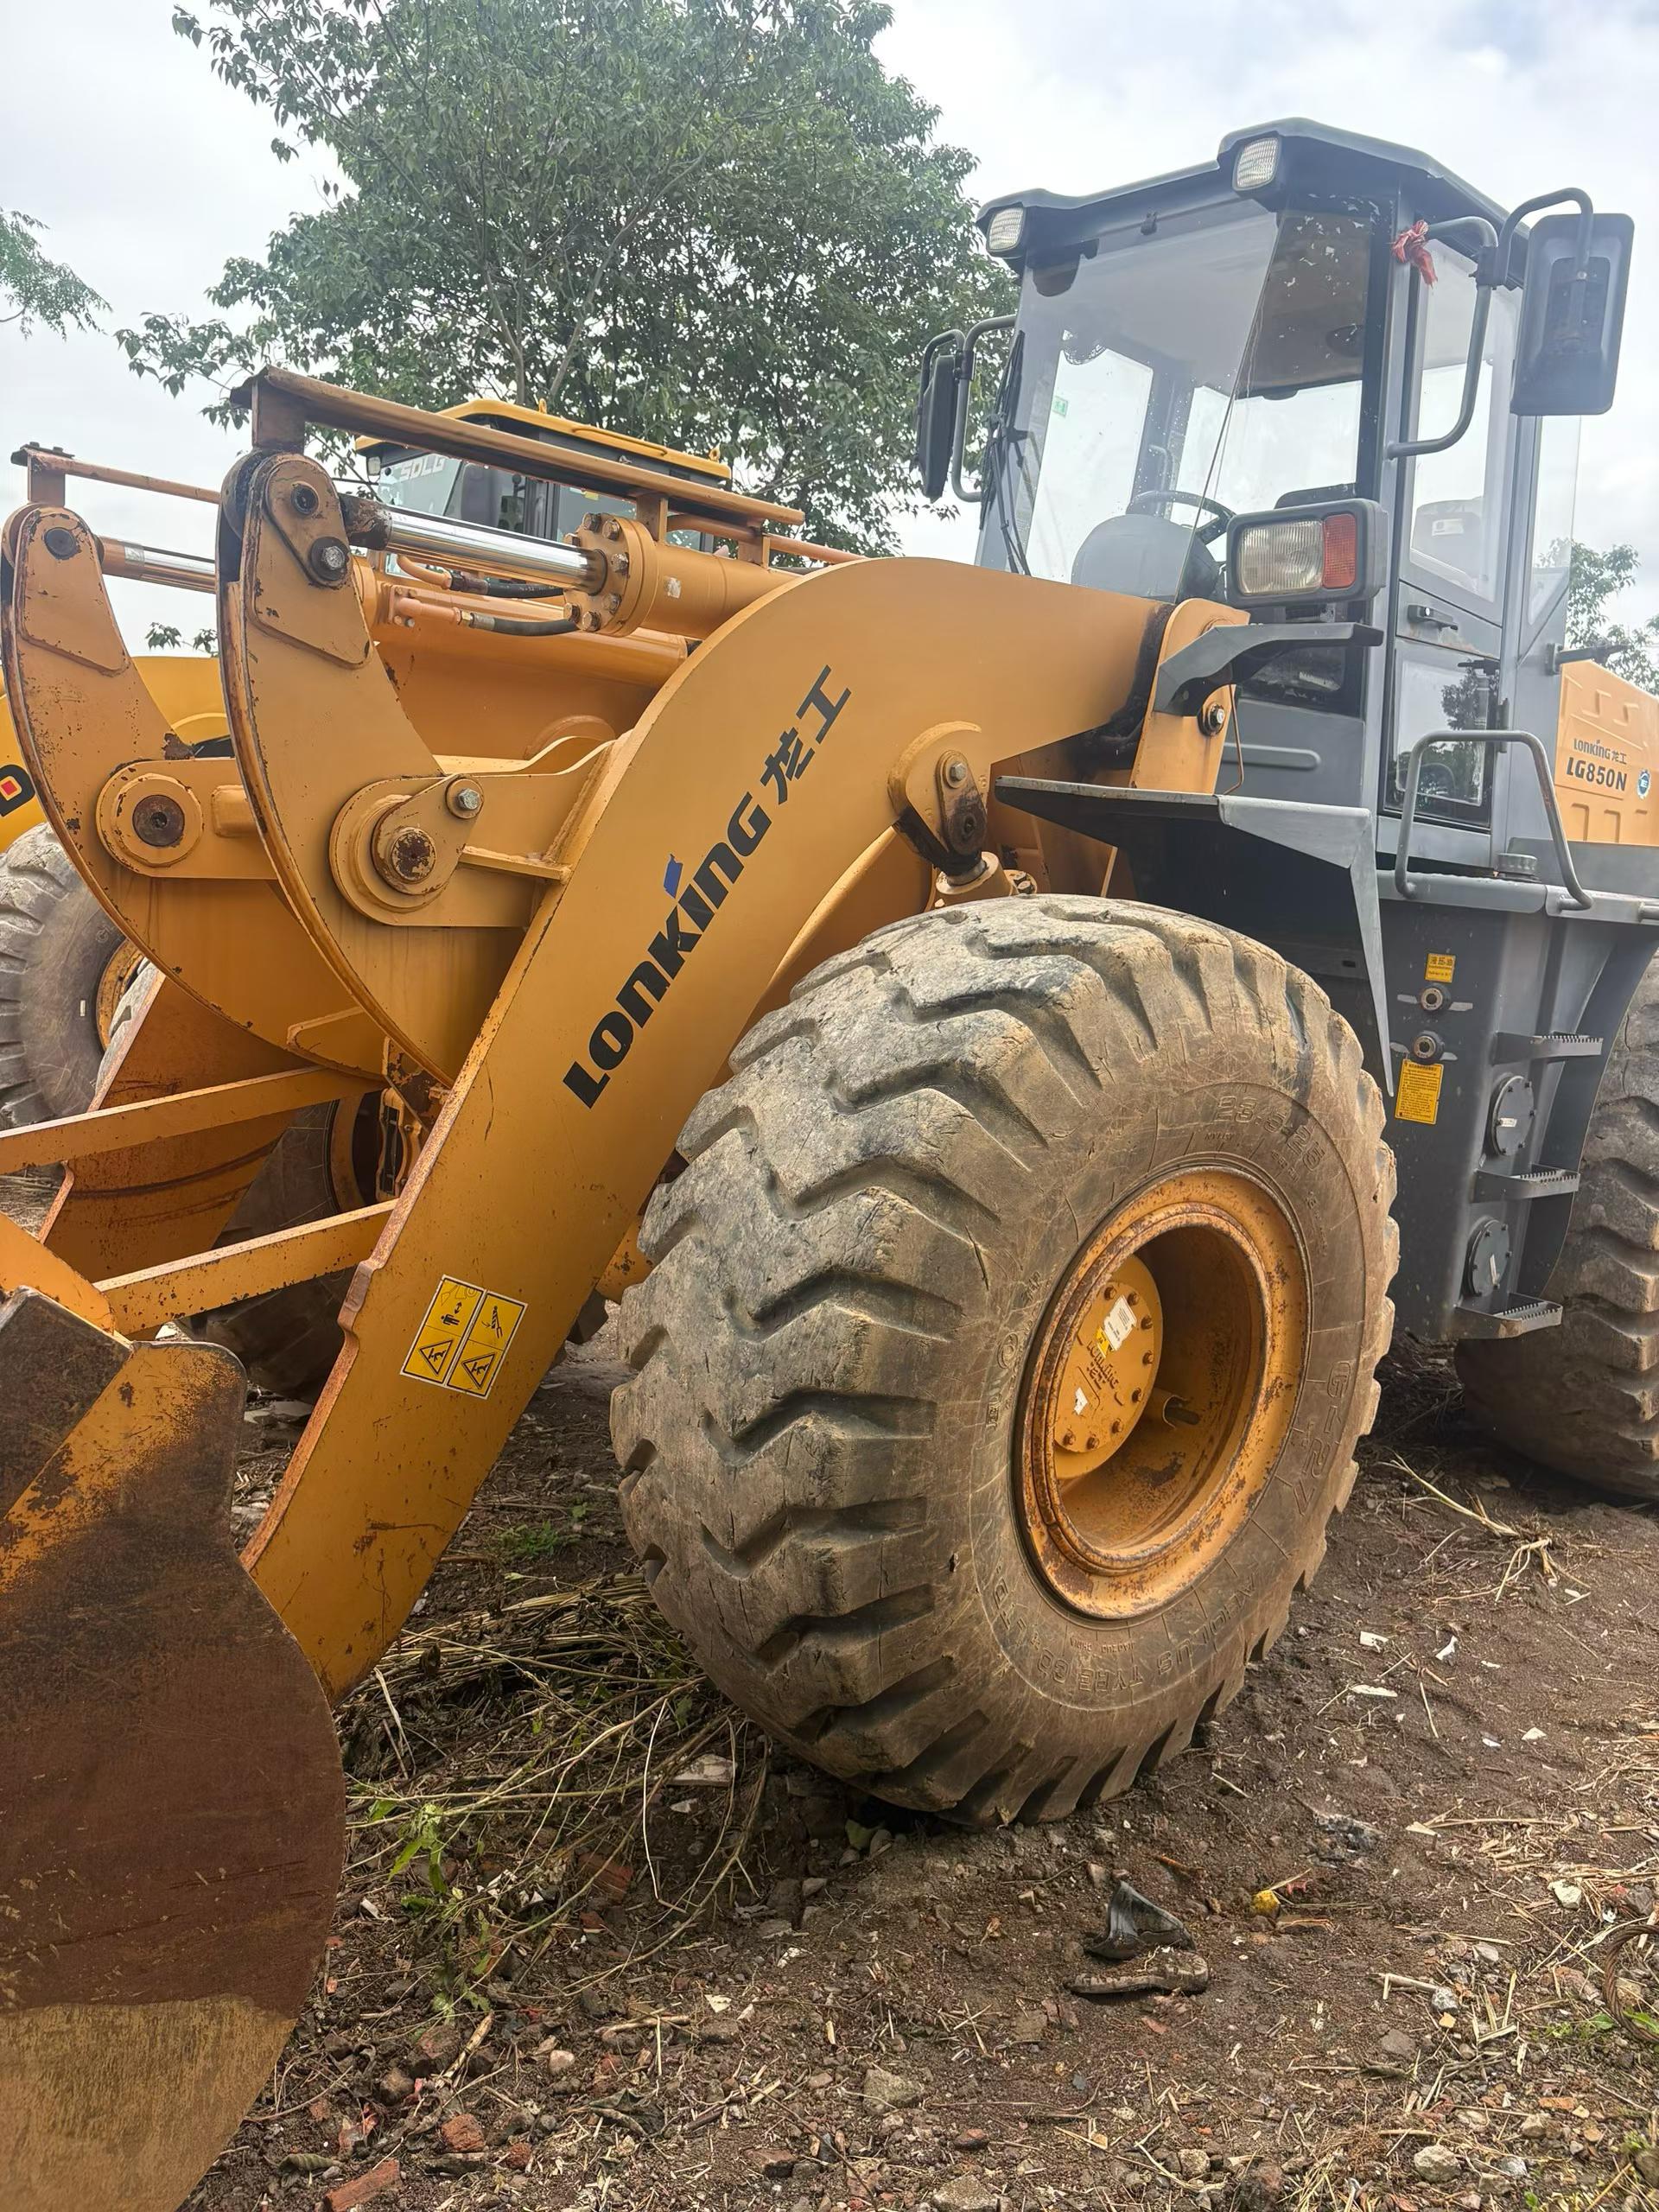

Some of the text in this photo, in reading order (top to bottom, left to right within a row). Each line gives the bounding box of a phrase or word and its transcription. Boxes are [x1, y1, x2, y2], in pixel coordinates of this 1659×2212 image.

[760, 664, 853, 805] 龙工
[1566, 756, 1628, 791] LG850N
[1611, 750, 1627, 766] 龙工
[1077, 1664, 1144, 1694] TYRE
